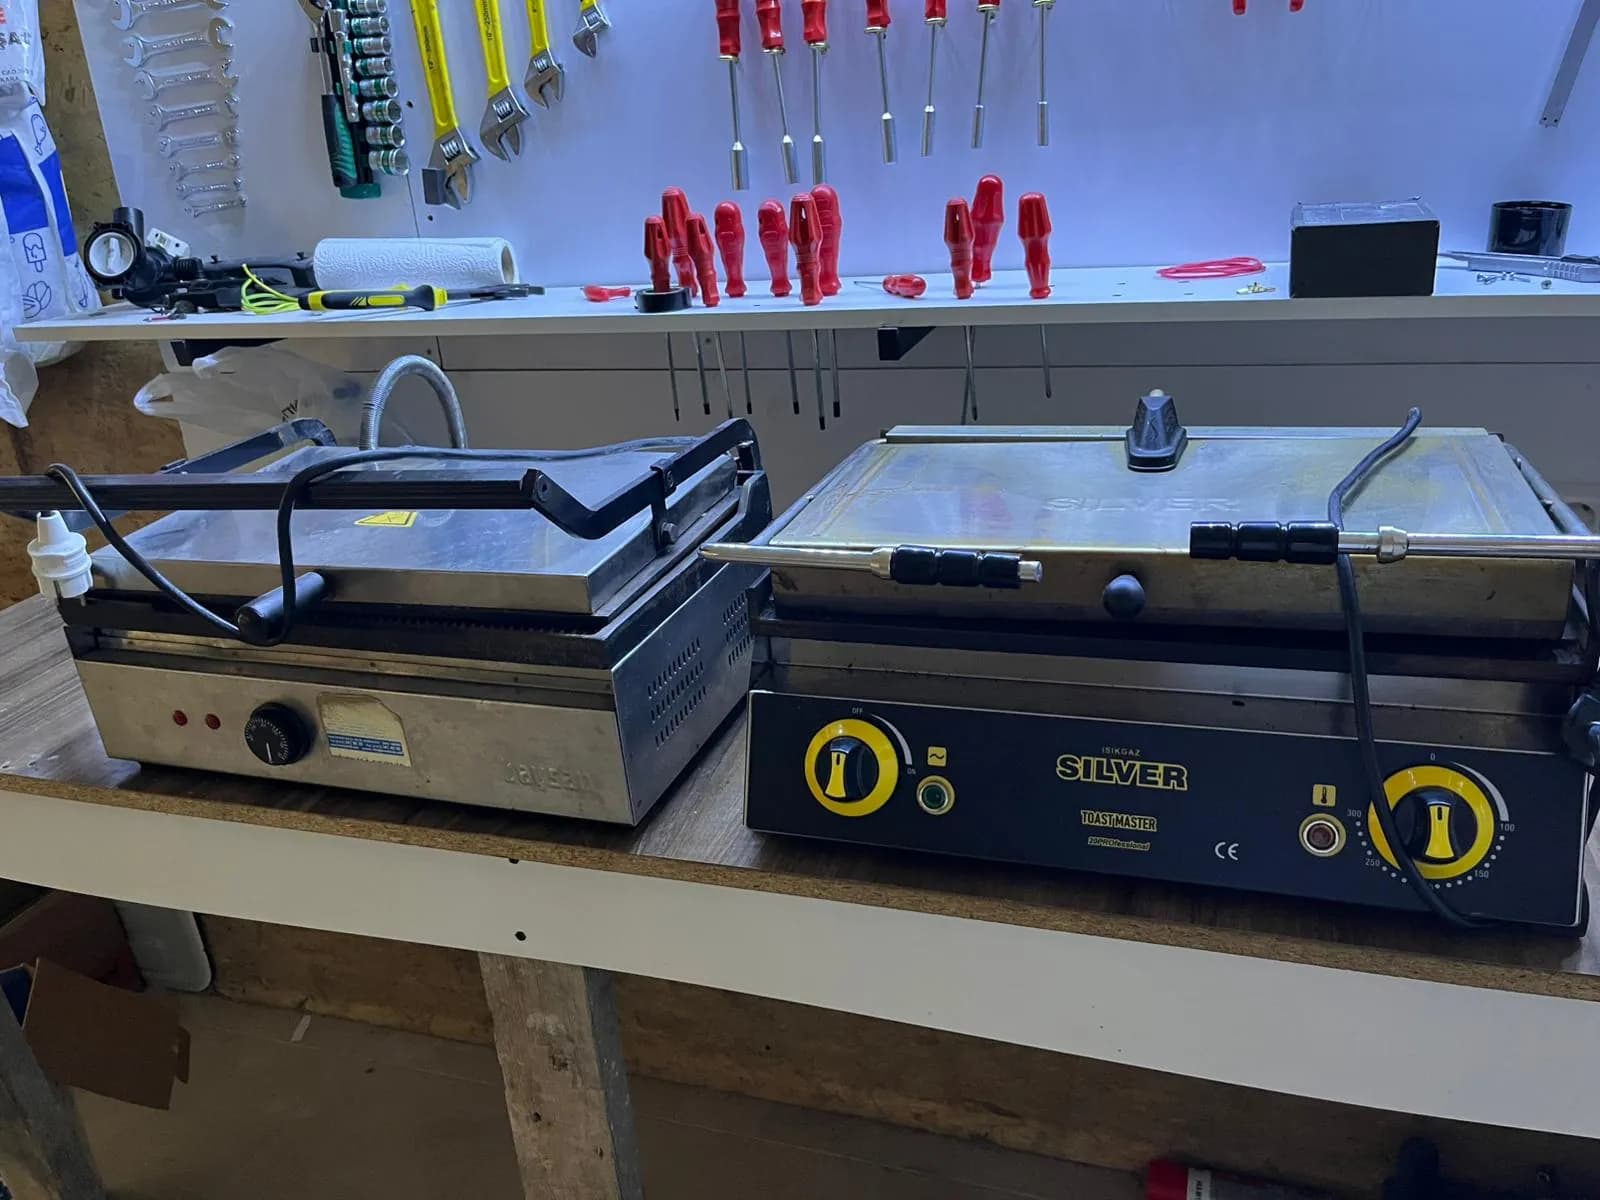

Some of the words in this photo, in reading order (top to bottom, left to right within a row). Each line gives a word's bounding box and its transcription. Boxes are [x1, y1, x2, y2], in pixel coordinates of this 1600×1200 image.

[1043, 497, 1240, 512] SILVER
[906, 767, 917, 775] ON
[1056, 754, 1188, 791] SILVER
[1347, 809, 1362, 818] 300
[1500, 823, 1515, 832] 100
[1214, 841, 1240, 861] CE
[1365, 858, 1380, 867] 250
[1474, 869, 1489, 878] 150
